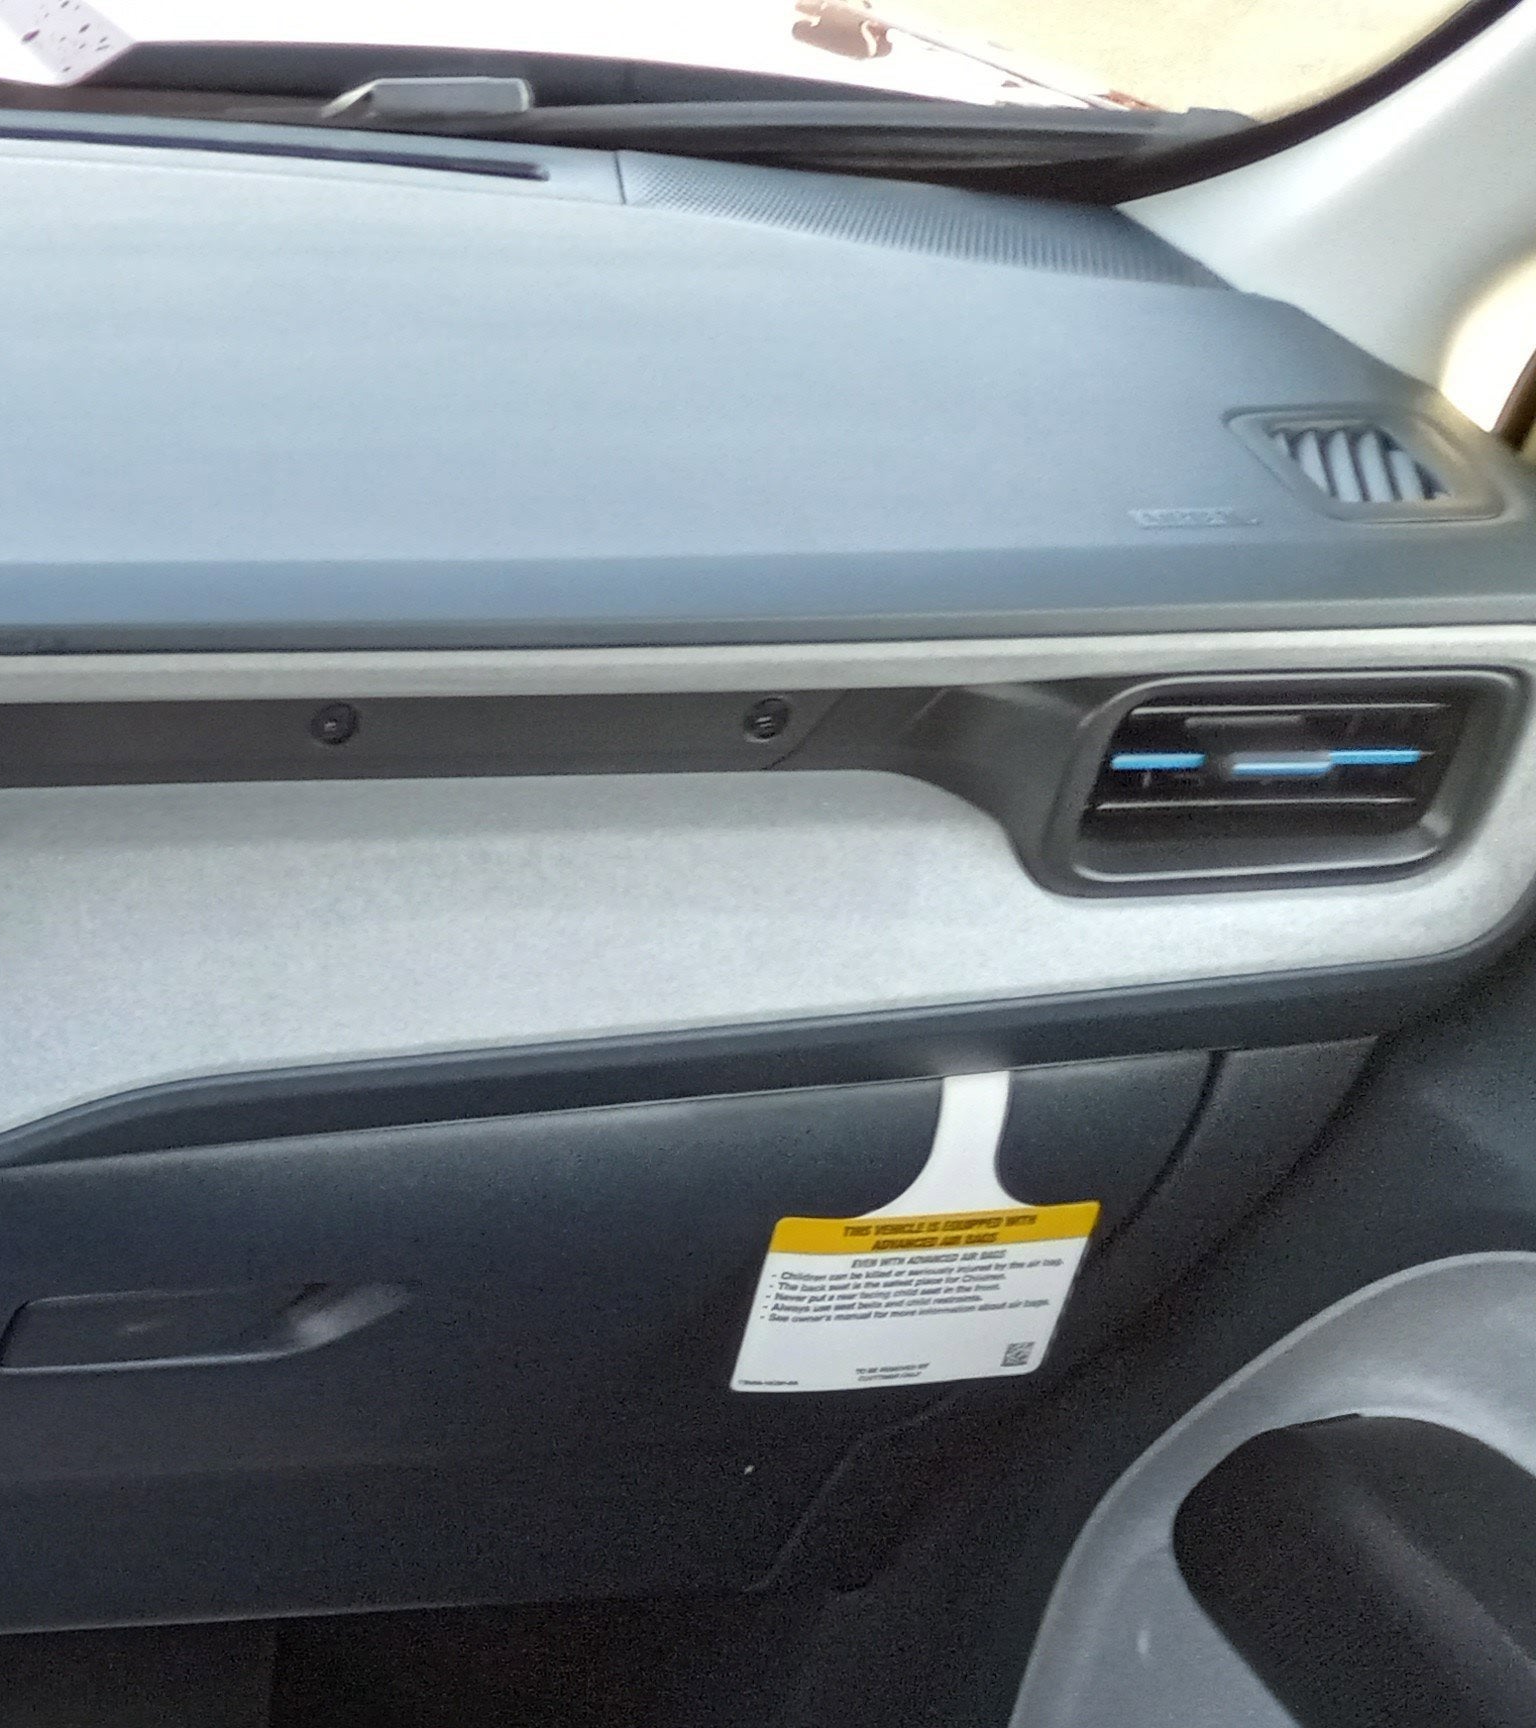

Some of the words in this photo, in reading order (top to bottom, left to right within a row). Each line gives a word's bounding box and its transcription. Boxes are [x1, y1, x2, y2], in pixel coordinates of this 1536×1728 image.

[874, 1222, 925, 1236] VEHICLE
[941, 1216, 1003, 1232] EQUIPPED
[1005, 1214, 1037, 1227] WITH
[872, 1237, 938, 1250] ADVANCED
[939, 1235, 962, 1246] AIR
[964, 1232, 1000, 1244] BAGS
[879, 1256, 906, 1267] WITH
[907, 1253, 959, 1265] ADVANCED
[960, 1252, 978, 1262] AIR
[781, 1271, 827, 1281] Children
[829, 1273, 848, 1281] can
[850, 1271, 863, 1280] be
[865, 1269, 893, 1279] killed
[957, 1264, 992, 1273] injured
[778, 1282, 799, 1291] The
[774, 1292, 807, 1301] Never
[769, 1313, 789, 1322] See
